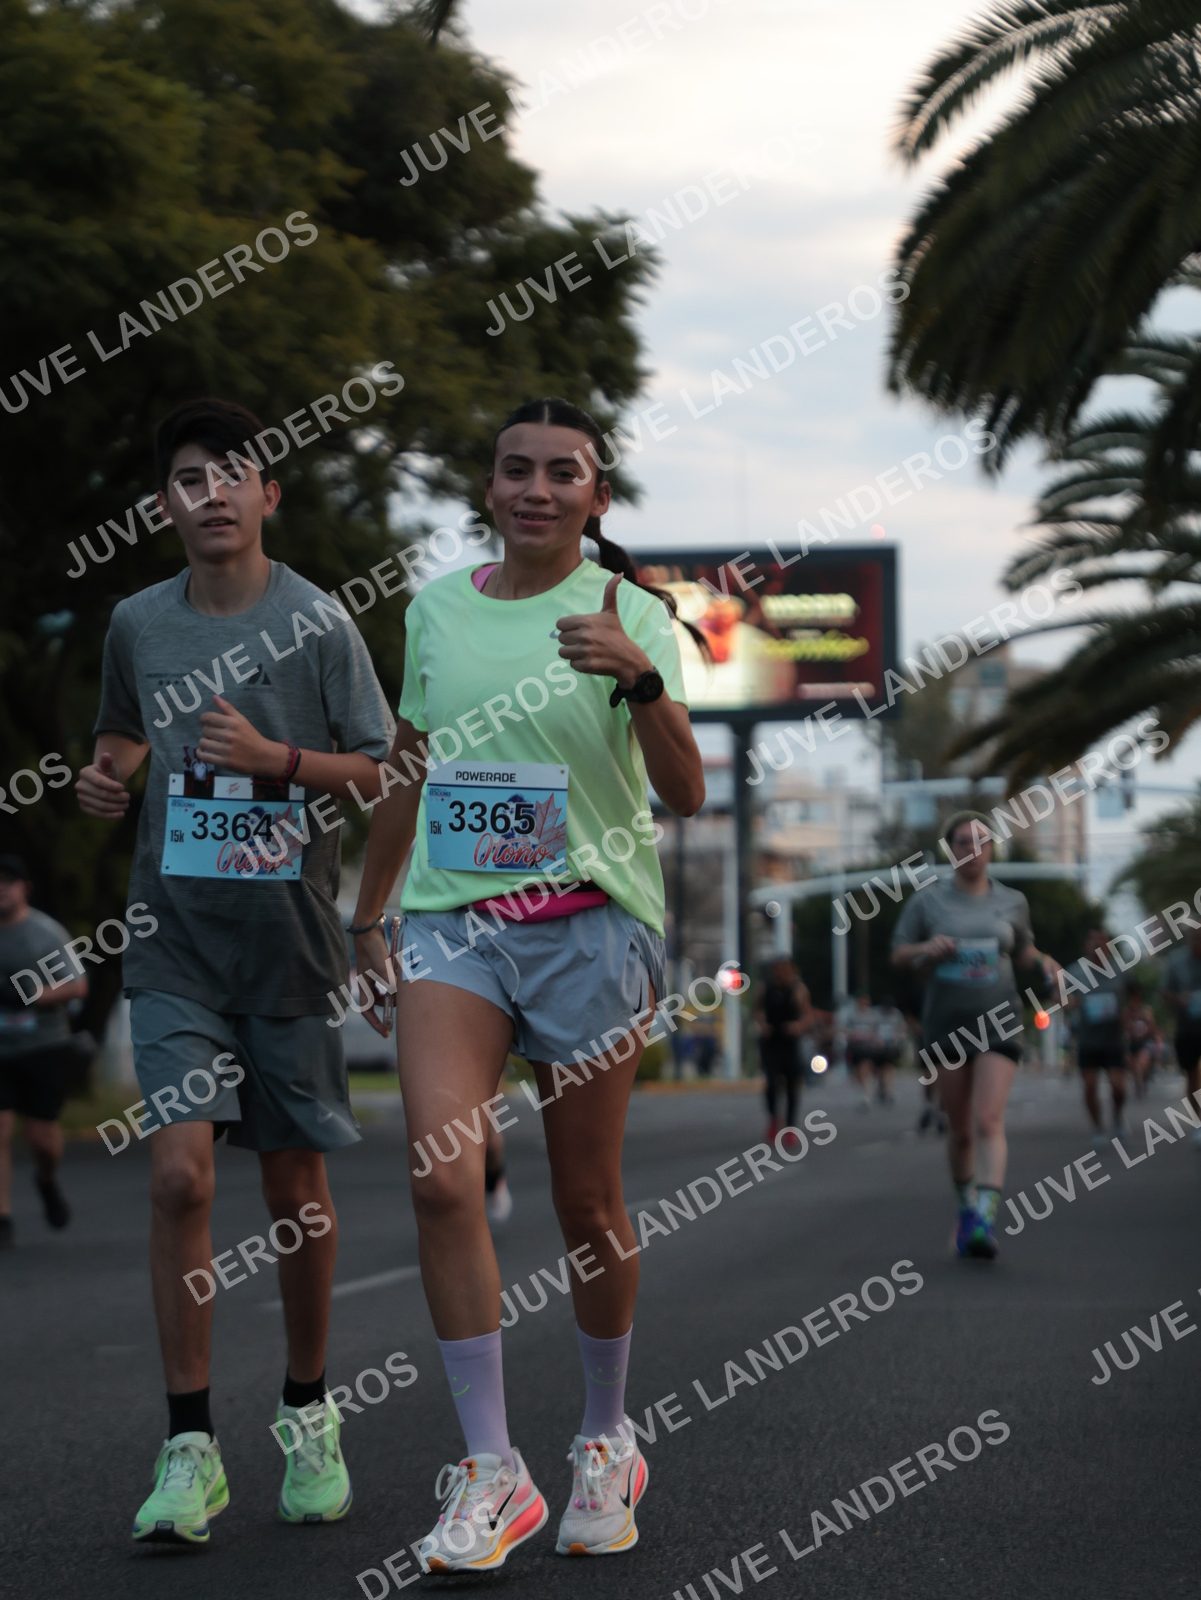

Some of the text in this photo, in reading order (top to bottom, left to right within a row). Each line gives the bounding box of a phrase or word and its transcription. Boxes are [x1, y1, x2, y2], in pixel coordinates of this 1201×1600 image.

[455, 770, 517, 783] POWERADE
[191, 810, 275, 843] 3364
[448, 800, 536, 835] 3365
